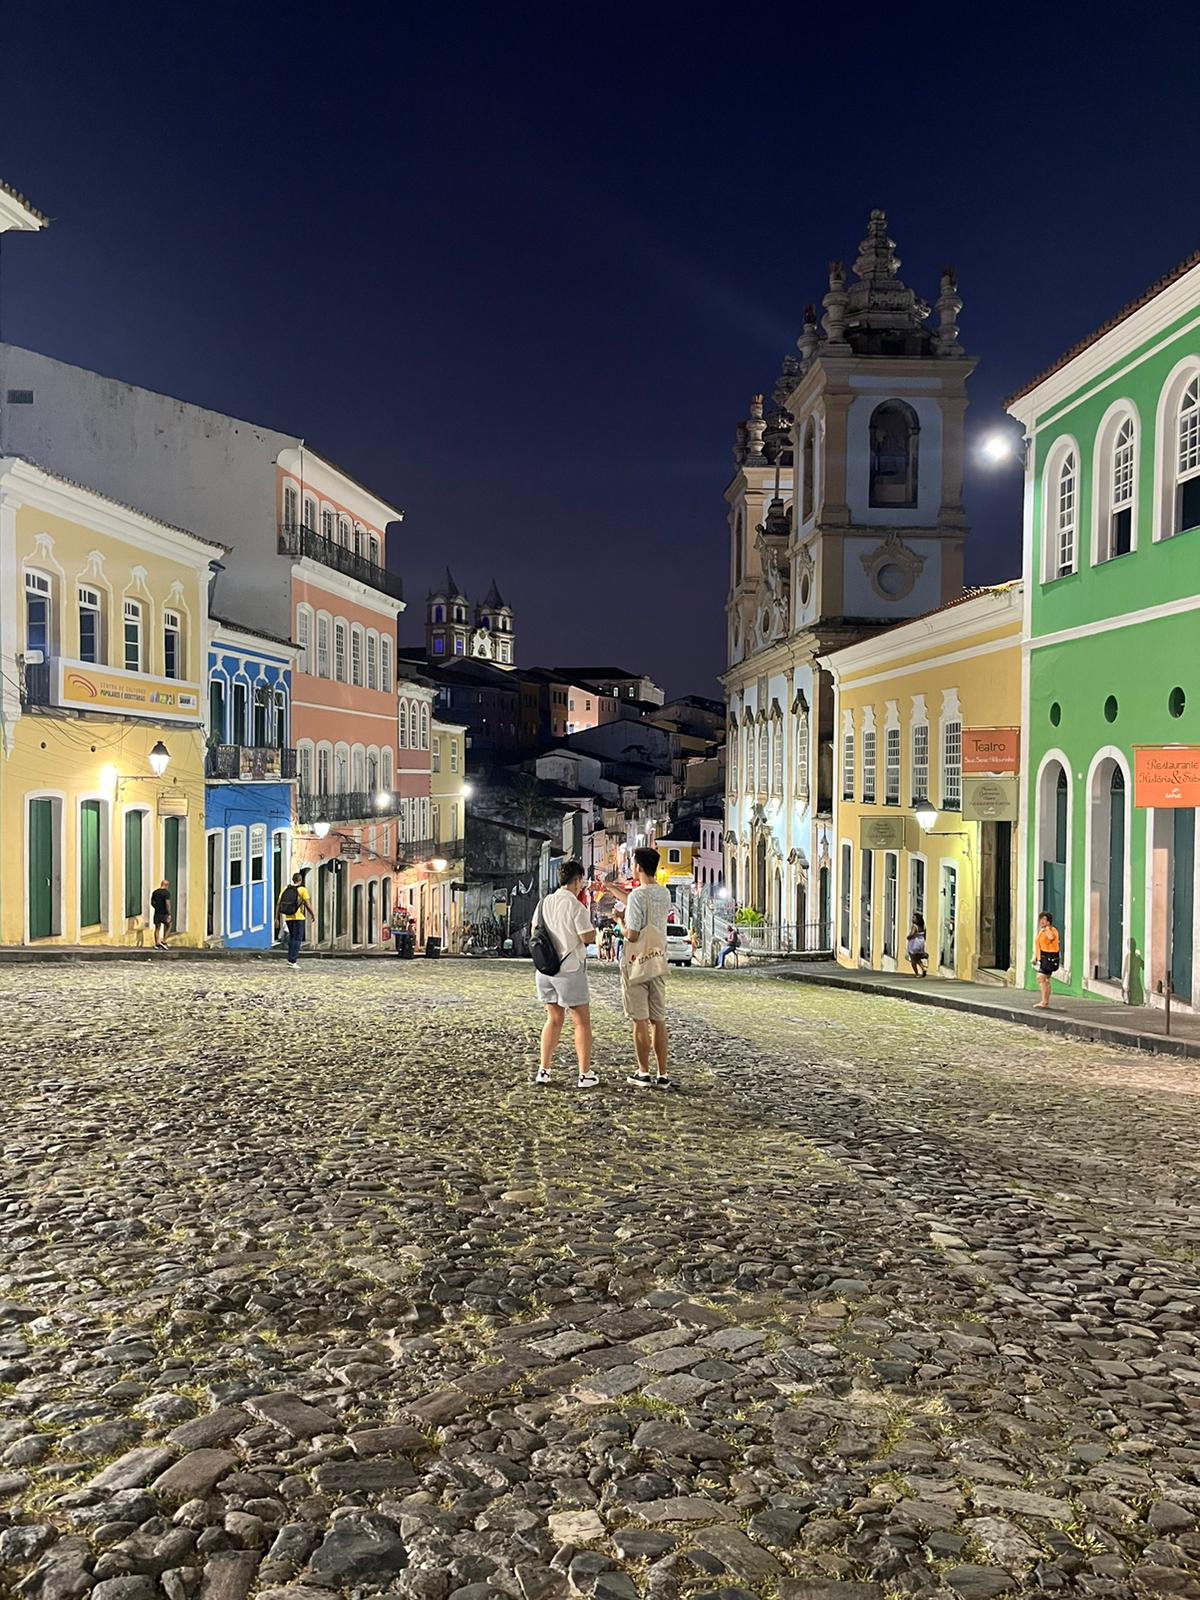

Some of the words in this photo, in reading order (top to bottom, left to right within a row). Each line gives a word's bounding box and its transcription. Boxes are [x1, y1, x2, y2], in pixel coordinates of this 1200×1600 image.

[971, 739, 1006, 752] Teatro
[1146, 758, 1199, 770] Restaurante
[1171, 769, 1181, 785] &
